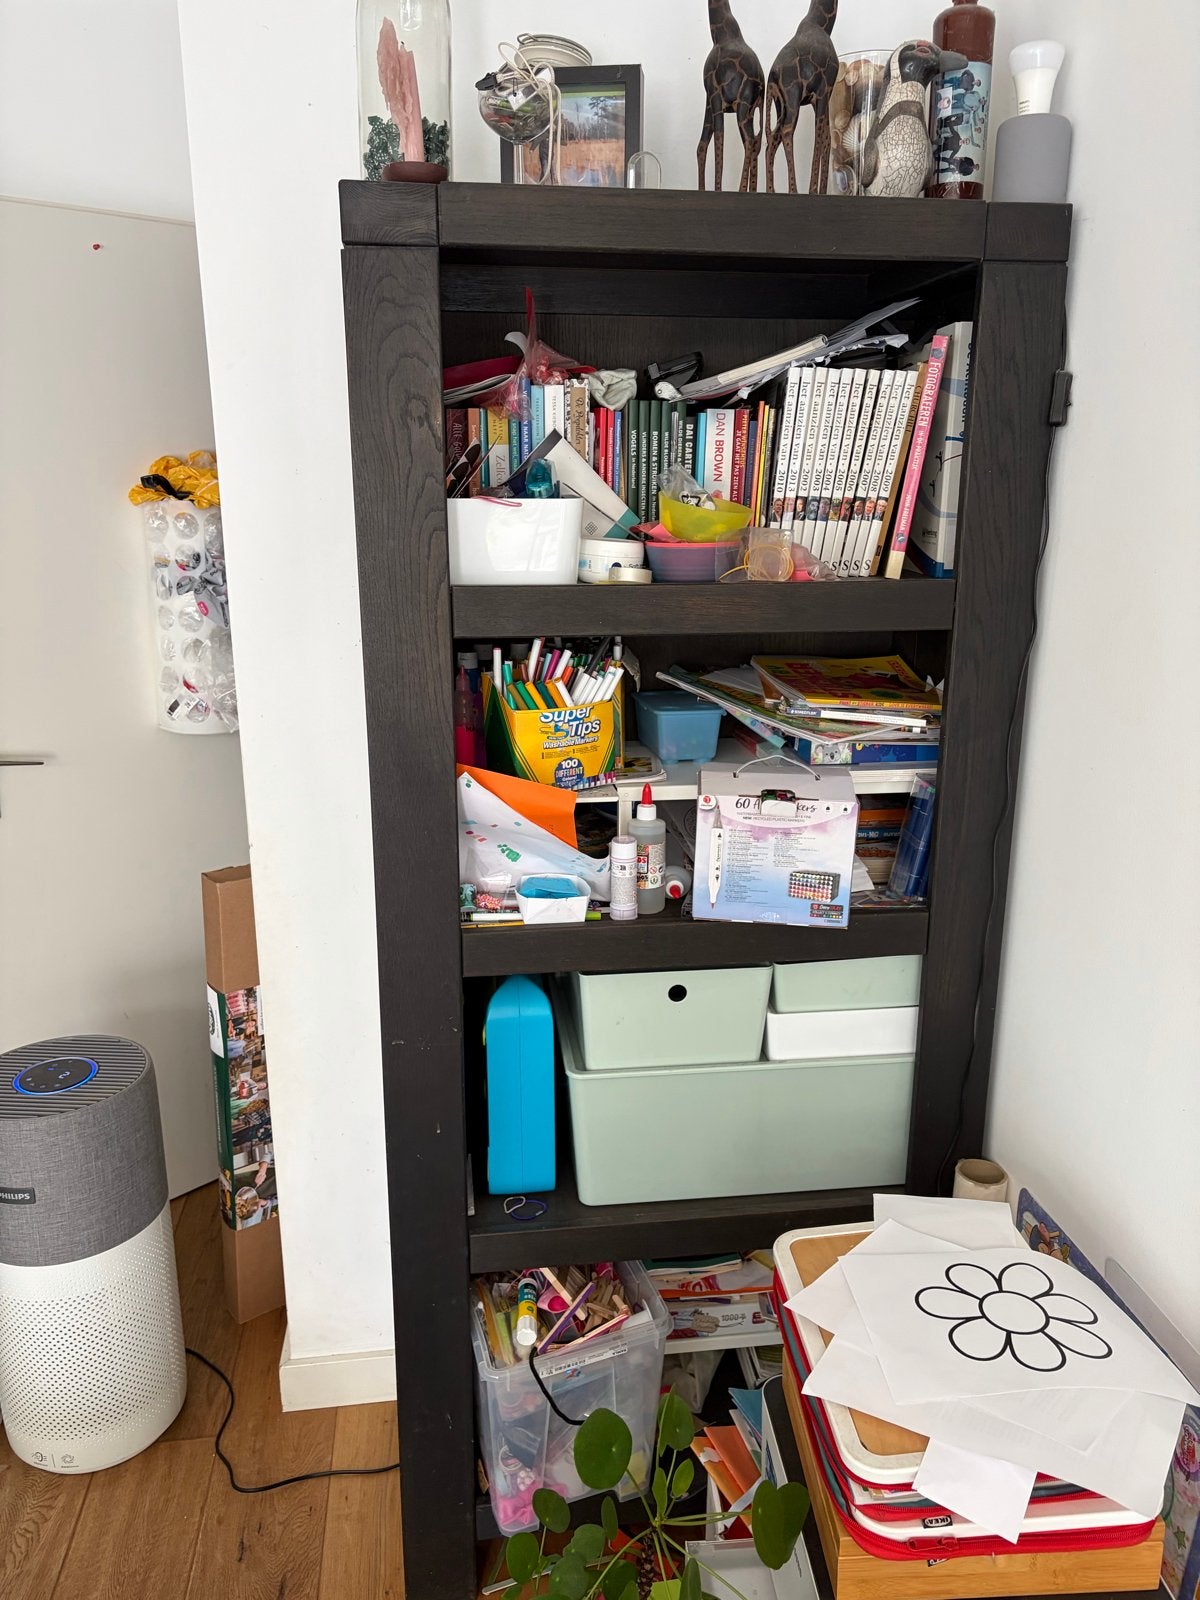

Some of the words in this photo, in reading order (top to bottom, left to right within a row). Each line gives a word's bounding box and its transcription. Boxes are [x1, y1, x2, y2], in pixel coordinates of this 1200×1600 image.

[788, 381, 798, 398] het
[800, 381, 811, 398] het
[815, 381, 825, 398] het
[828, 381, 840, 399] het
[839, 382, 850, 399] het
[852, 382, 863, 400] het
[867, 383, 877, 400] het
[881, 383, 891, 400] het
[891, 383, 902, 400] het
[904, 383, 915, 400] het
[918, 361, 940, 428] FOTOGRAFEREN
[715, 412, 726, 437] DAN
[783, 401, 793, 440] aanzien
[795, 401, 806, 440] aanzien
[808, 401, 820, 440] aanzien
[821, 401, 834, 441] aanzien
[832, 401, 844, 441] aanzien
[845, 402, 857, 442] aanzien
[859, 402, 870, 441] aanzien
[871, 402, 884, 441] aanzien
[882, 403, 895, 441] aanzien
[894, 402, 907, 441] aanzien
[736, 429, 742, 437] JE
[780, 443, 788, 461] van
[792, 442, 800, 461] van
[805, 443, 814, 461] van
[818, 442, 827, 461] van
[829, 443, 838, 461] van
[841, 443, 850, 462] van
[854, 444, 862, 461] van
[867, 443, 875, 461] van
[877, 443, 886, 461] van
[890, 443, 898, 461] van
[713, 440, 725, 483] BROWN
[776, 470, 786, 493] 2010
[788, 470, 798, 492] 2013
[800, 469, 810, 492] 2002
[812, 469, 823, 492] 2003
[823, 469, 834, 492] 2004
[835, 469, 846, 492] 2005
[846, 469, 857, 492] 2006
[860, 469, 871, 492] 2007
[871, 469, 881, 493] 2008
[882, 469, 893, 492] 2009
[842, 559, 849, 571] S
[852, 559, 860, 571] S
[863, 559, 871, 571] S
[540, 706, 594, 723] Super
[570, 719, 601, 737] Tips
[543, 740, 575, 749] Washable
[575, 735, 599, 746] Markers
[555, 766, 584, 778] DIFFERENT
[561, 759, 579, 769] 100
[735, 798, 751, 809] 60
[796, 802, 817, 813] kers
[721, 1313, 739, 1322] 1000
[929, 1516, 949, 1525] IKEA
